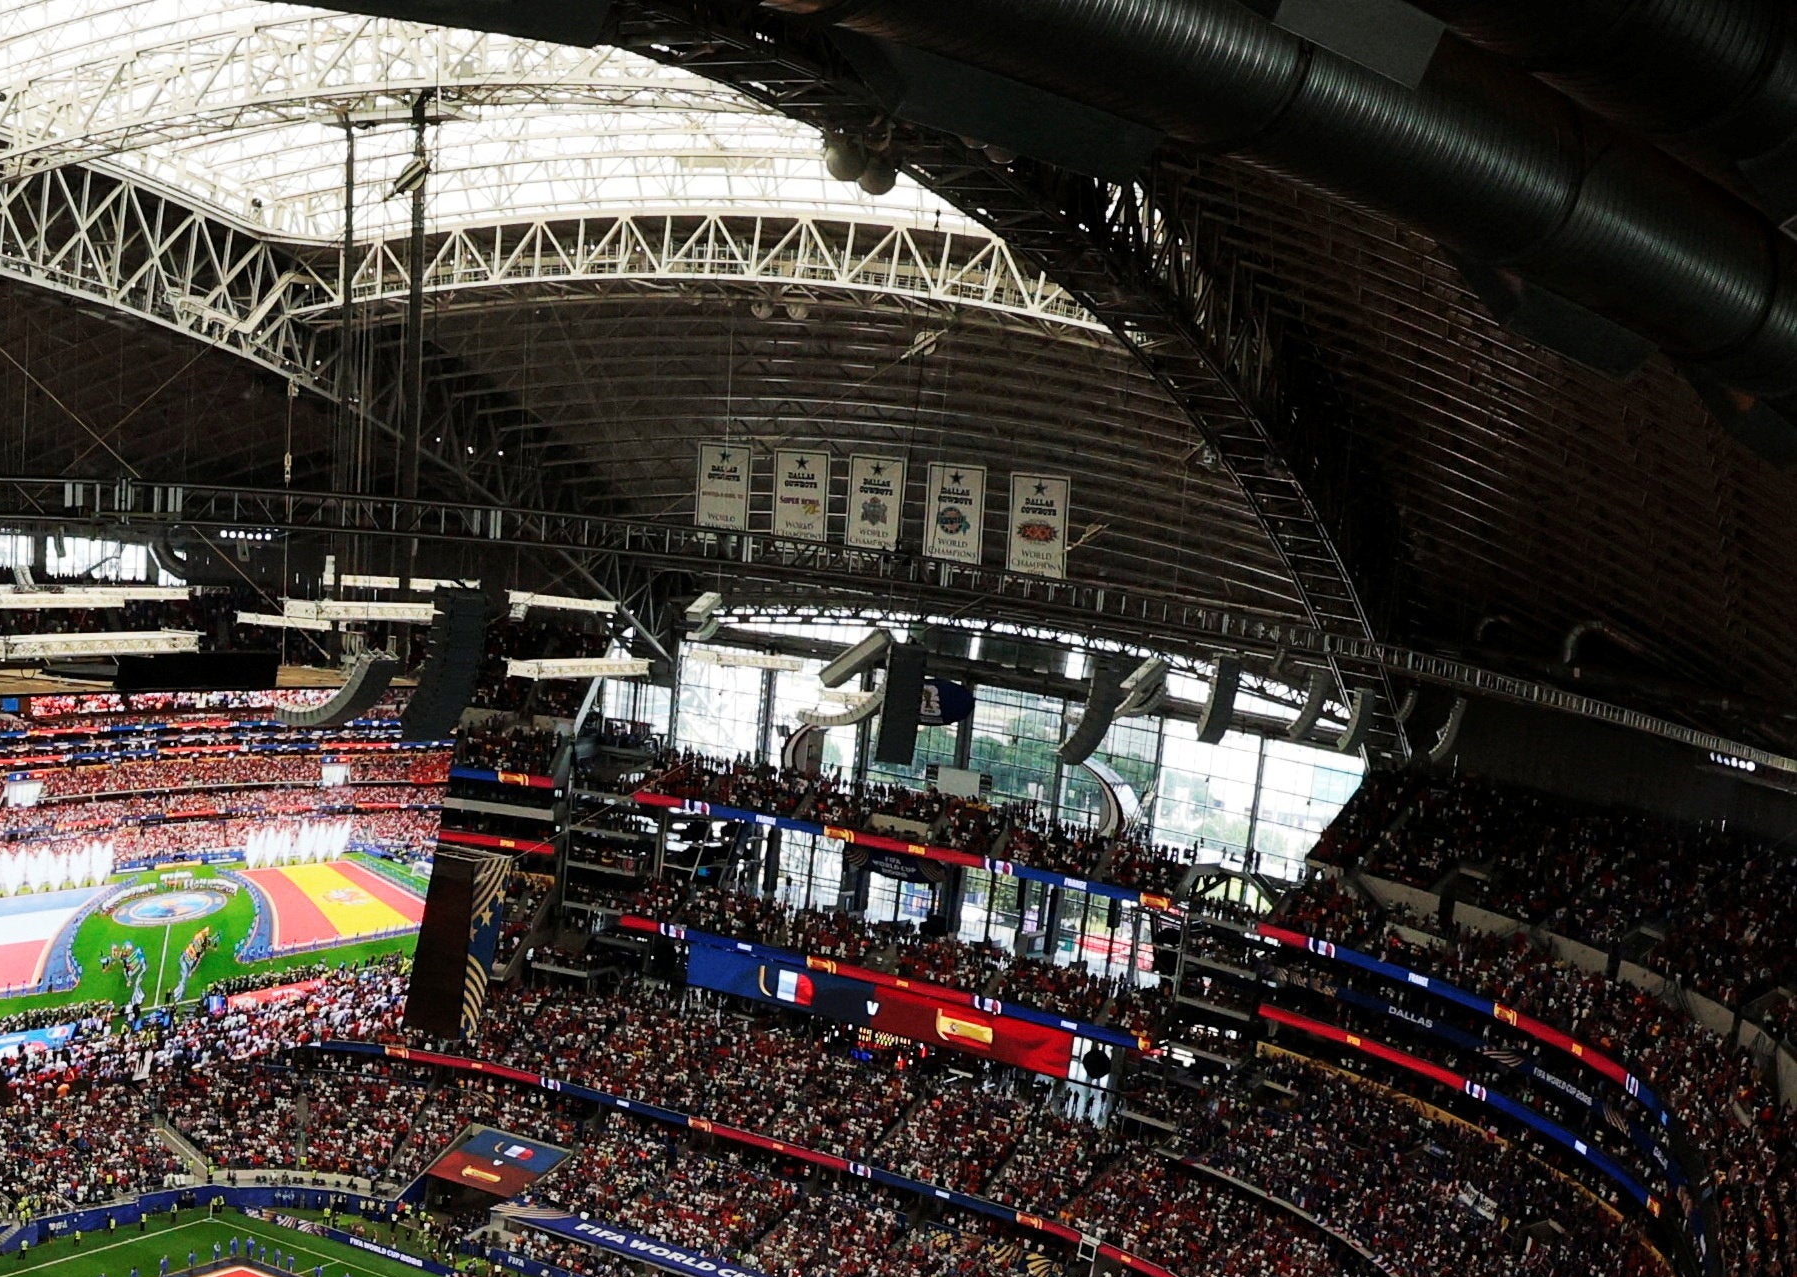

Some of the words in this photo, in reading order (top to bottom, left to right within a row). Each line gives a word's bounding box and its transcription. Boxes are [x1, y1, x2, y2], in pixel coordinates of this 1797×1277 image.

[788, 471, 815, 480] DALLAS
[863, 477, 891, 488] DALLAS
[859, 486, 893, 496] COWBOYS
[941, 487, 970, 497] DALLAS
[938, 494, 973, 505] COWBOYS
[1025, 497, 1054, 507] DALLAS
[1020, 506, 1057, 516] COWBOYS
[859, 528, 889, 538] WORLD
[937, 537, 968, 549] WORLD
[1021, 549, 1052, 561] WORLD
[1388, 1005, 1434, 1029] DALLAS
[349, 1236, 364, 1249] FIFA
[364, 1241, 386, 1255] WORLD
[386, 1249, 400, 1260] CUP
[574, 1222, 626, 1245] FIFA
[629, 1238, 718, 1272] WORLD
[508, 1255, 525, 1268] FIFA
